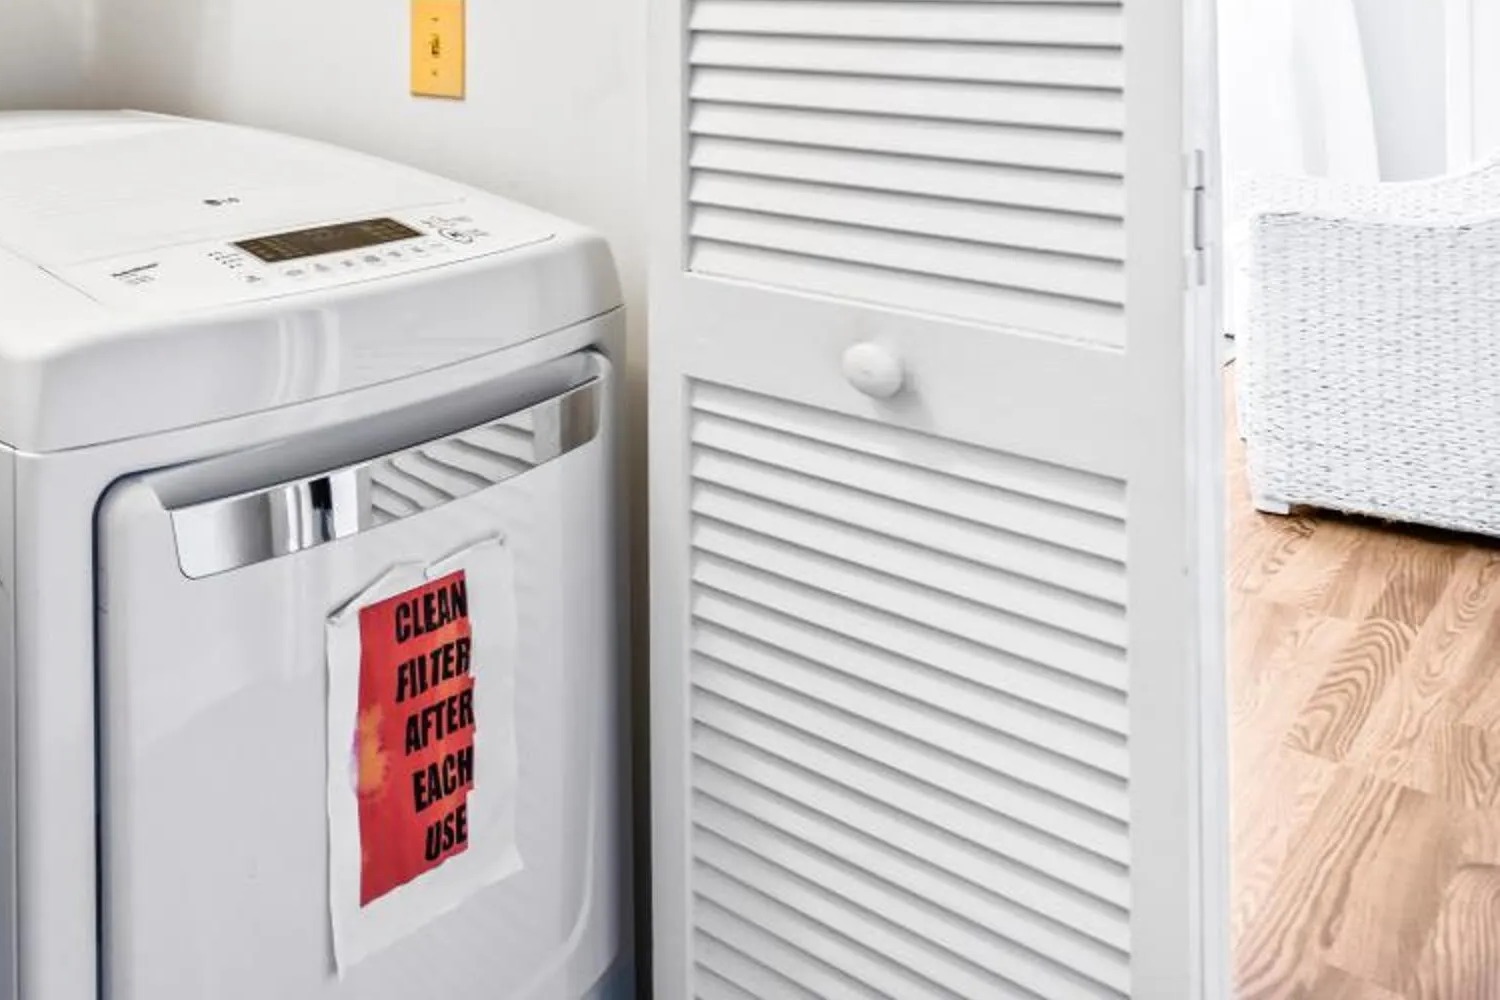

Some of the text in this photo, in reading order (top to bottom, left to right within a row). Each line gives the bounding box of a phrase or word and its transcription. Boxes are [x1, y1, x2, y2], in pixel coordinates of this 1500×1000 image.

[395, 580, 467, 645] CLEAN
[395, 637, 471, 703] FILTER
[404, 687, 474, 756] AFTER
[412, 745, 473, 813] EACH
[424, 804, 467, 861] USE
